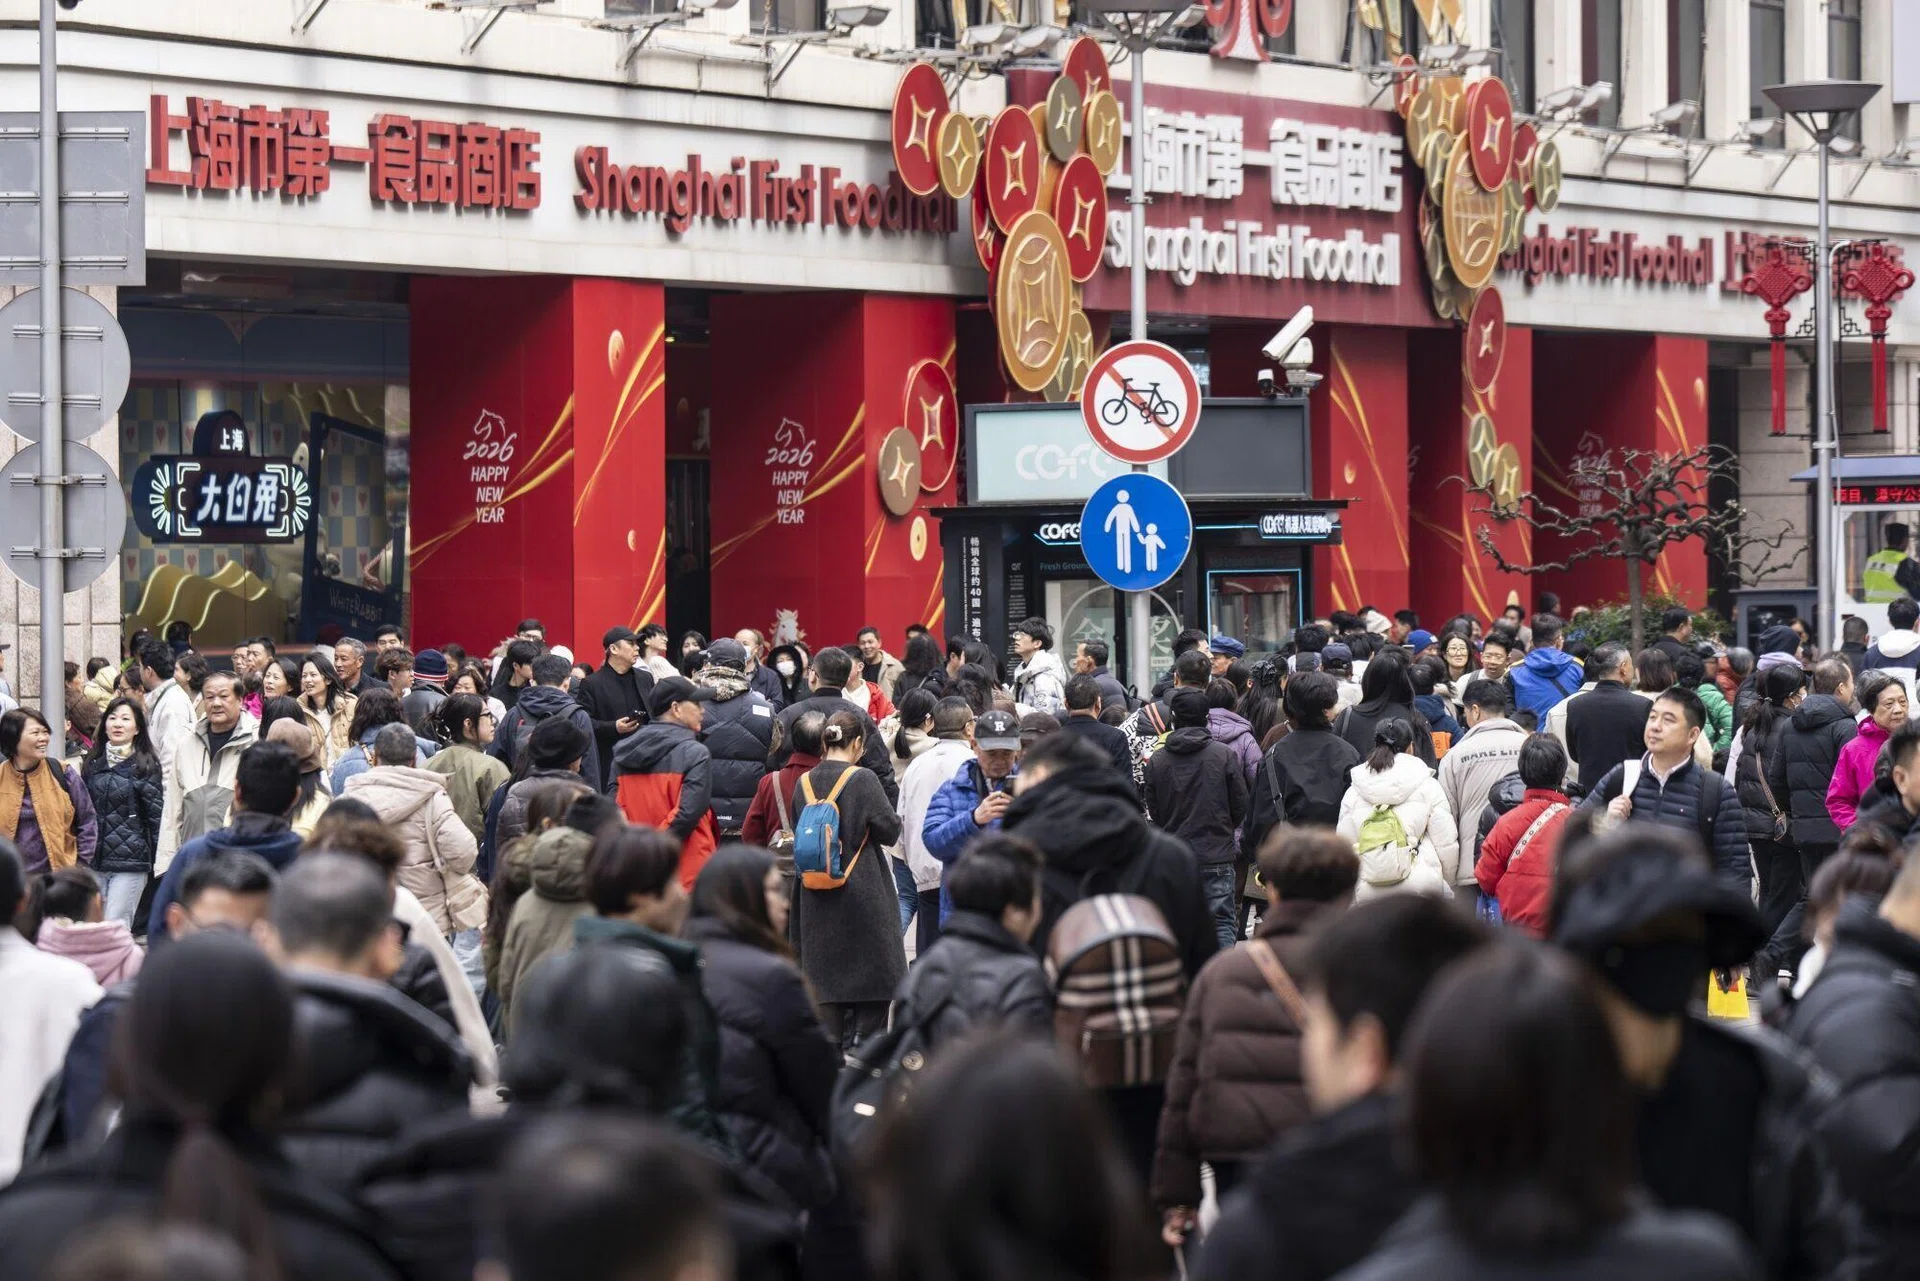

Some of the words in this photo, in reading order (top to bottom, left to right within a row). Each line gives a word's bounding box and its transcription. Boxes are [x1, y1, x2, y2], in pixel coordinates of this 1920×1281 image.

[147, 94, 541, 210] 上海市第一食品商店
[1106, 101, 1402, 212] 上海市第一食品商店
[573, 145, 746, 233] Shanghai
[750, 159, 817, 224] First
[1238, 220, 1291, 280] First
[1291, 225, 1400, 286] Foodhall
[1577, 228, 1621, 279] First
[1623, 232, 1714, 285] Foodhall
[219, 428, 245, 452] 上海
[462, 432, 518, 462] 2026
[764, 439, 817, 467] 2026
[470, 466, 510, 482] HAPPY
[772, 471, 809, 486] HAPPY
[197, 473, 280, 523] 大白兔
[476, 487, 505, 503] NEW
[777, 490, 804, 505] NEW
[476, 507, 505, 523] YEAR
[777, 509, 805, 524] YEAR
[994, 720, 1006, 731] R
